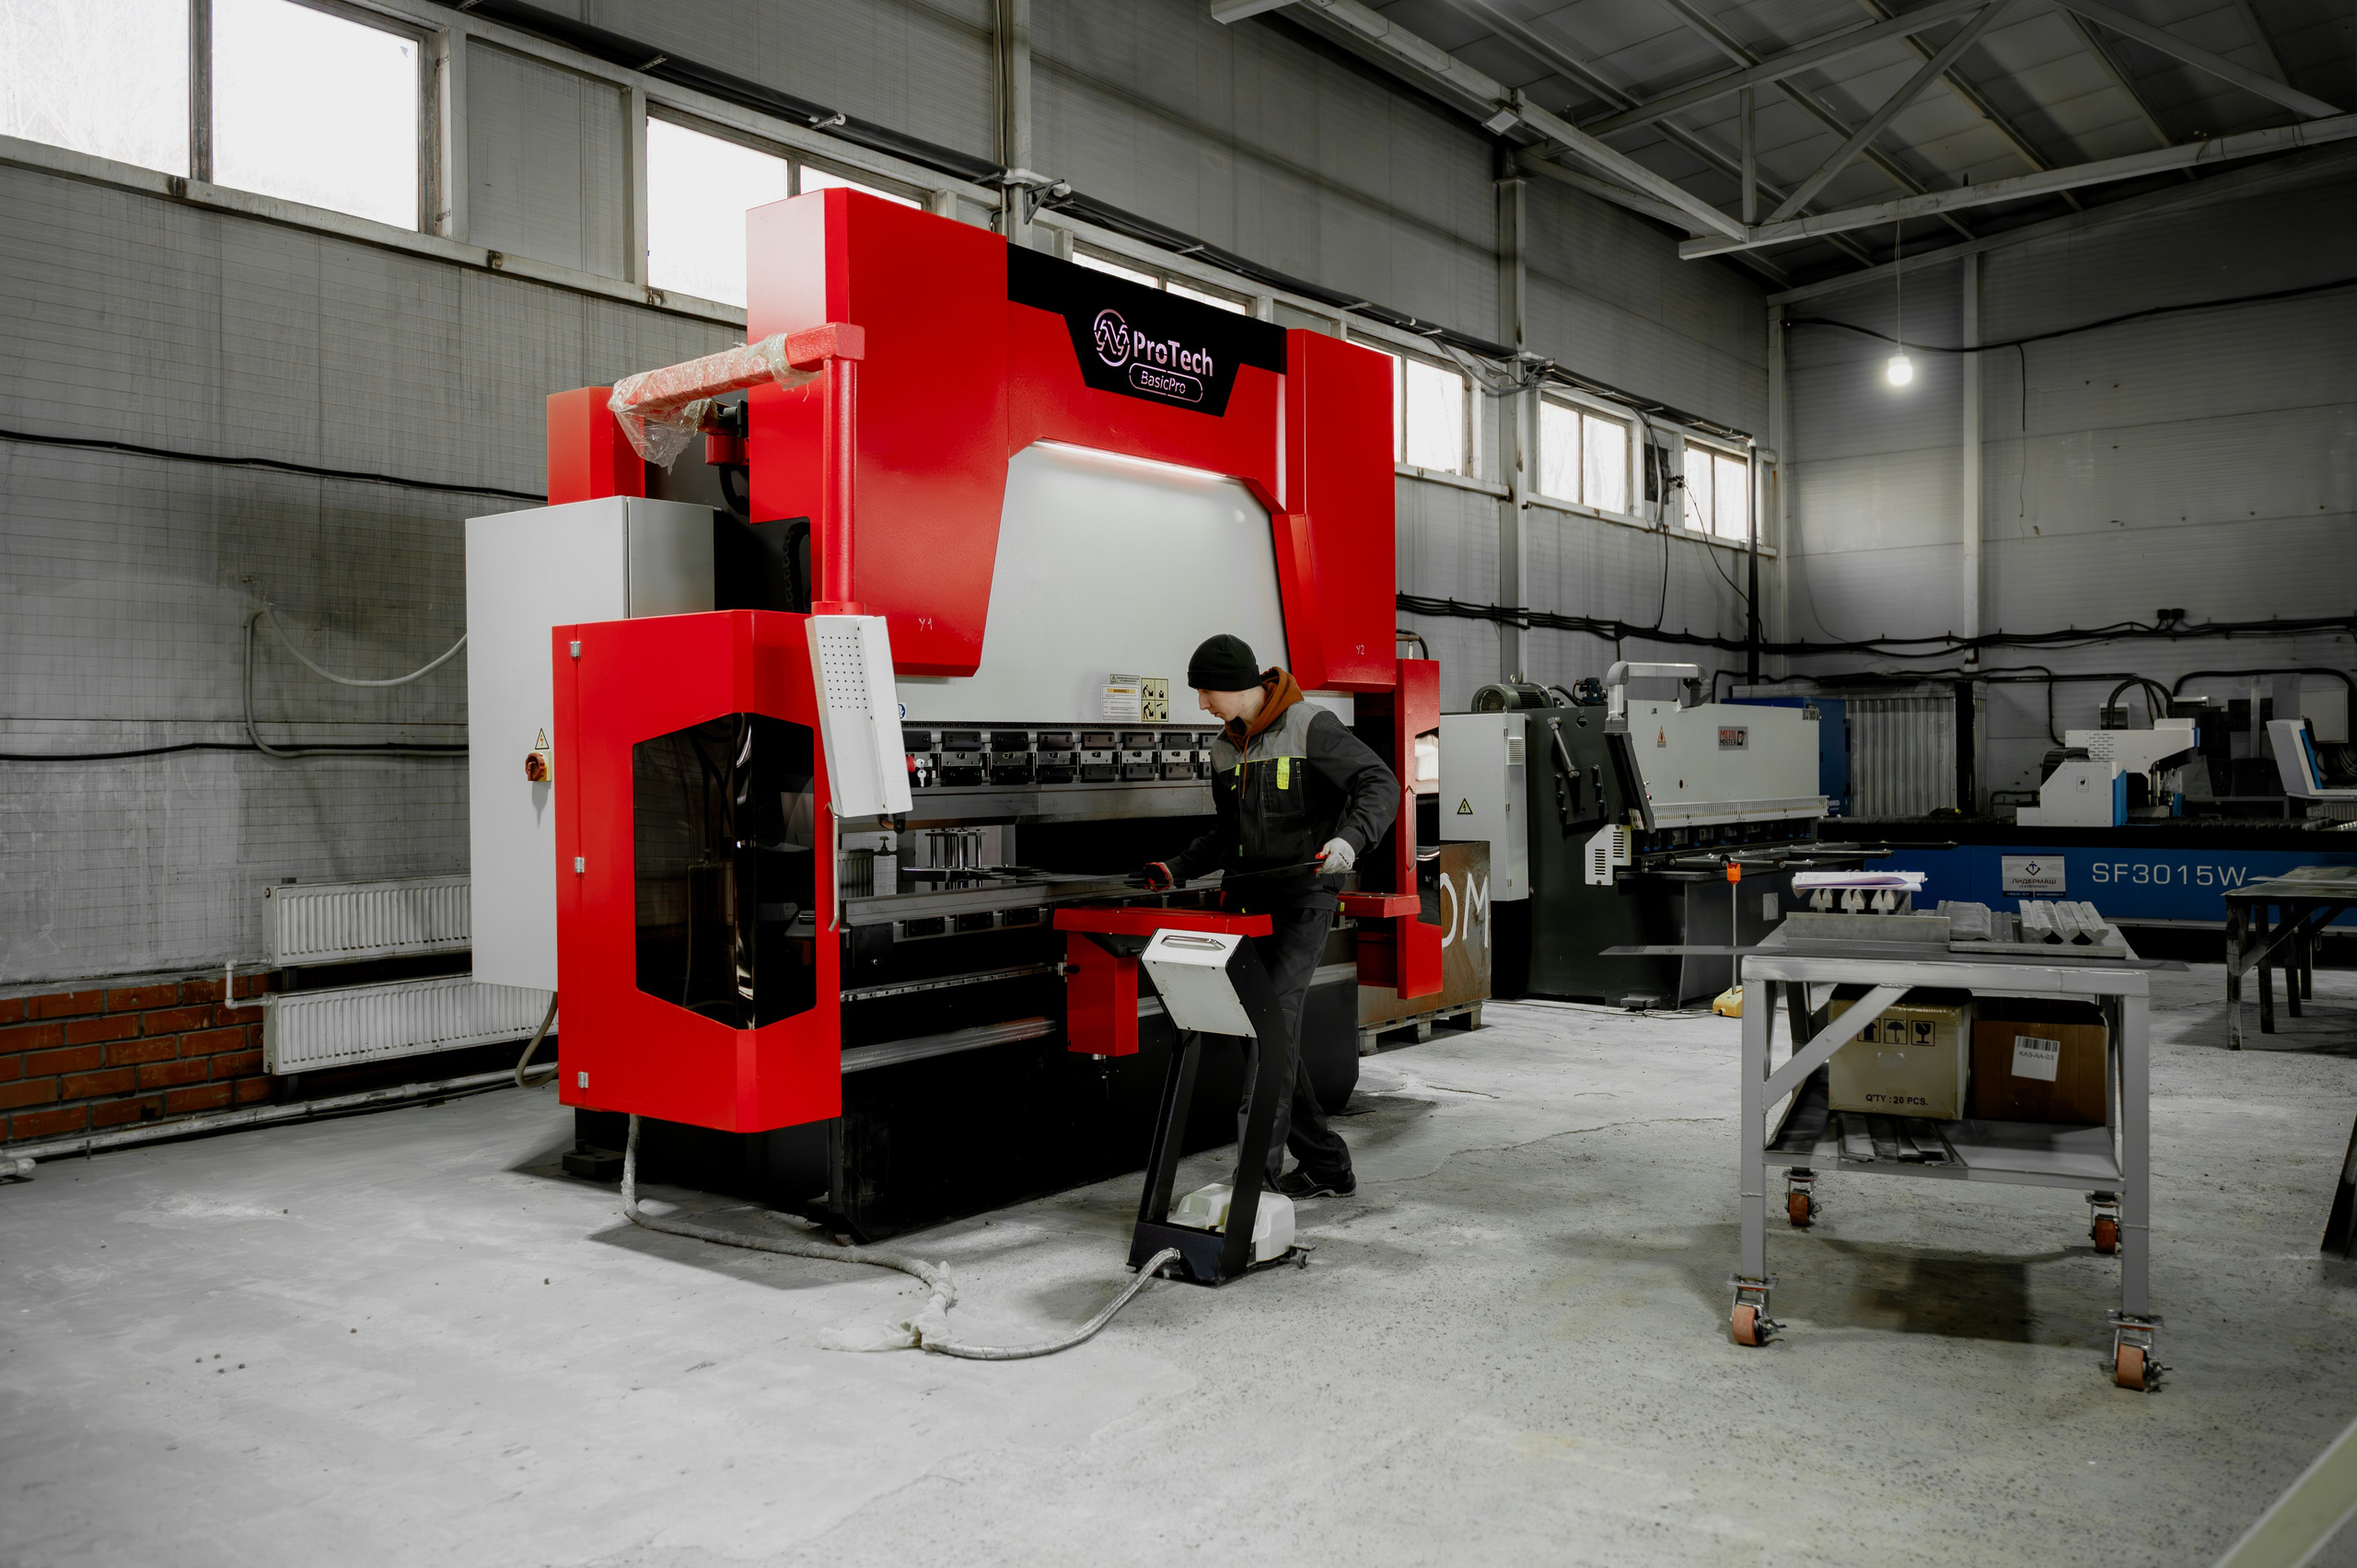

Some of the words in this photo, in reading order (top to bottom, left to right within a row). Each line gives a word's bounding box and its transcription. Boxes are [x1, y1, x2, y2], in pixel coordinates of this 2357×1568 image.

[1133, 331, 1213, 377] ProTech
[1141, 370, 1186, 394] BasicPro
[919, 617, 933, 632] Y1
[1355, 645, 1364, 655] Y2
[1720, 729, 1737, 739] METAL
[2092, 863, 2247, 887] SF3015W
[1893, 1096, 1904, 1104] 20
[1907, 1097, 1928, 1106] PCS.
